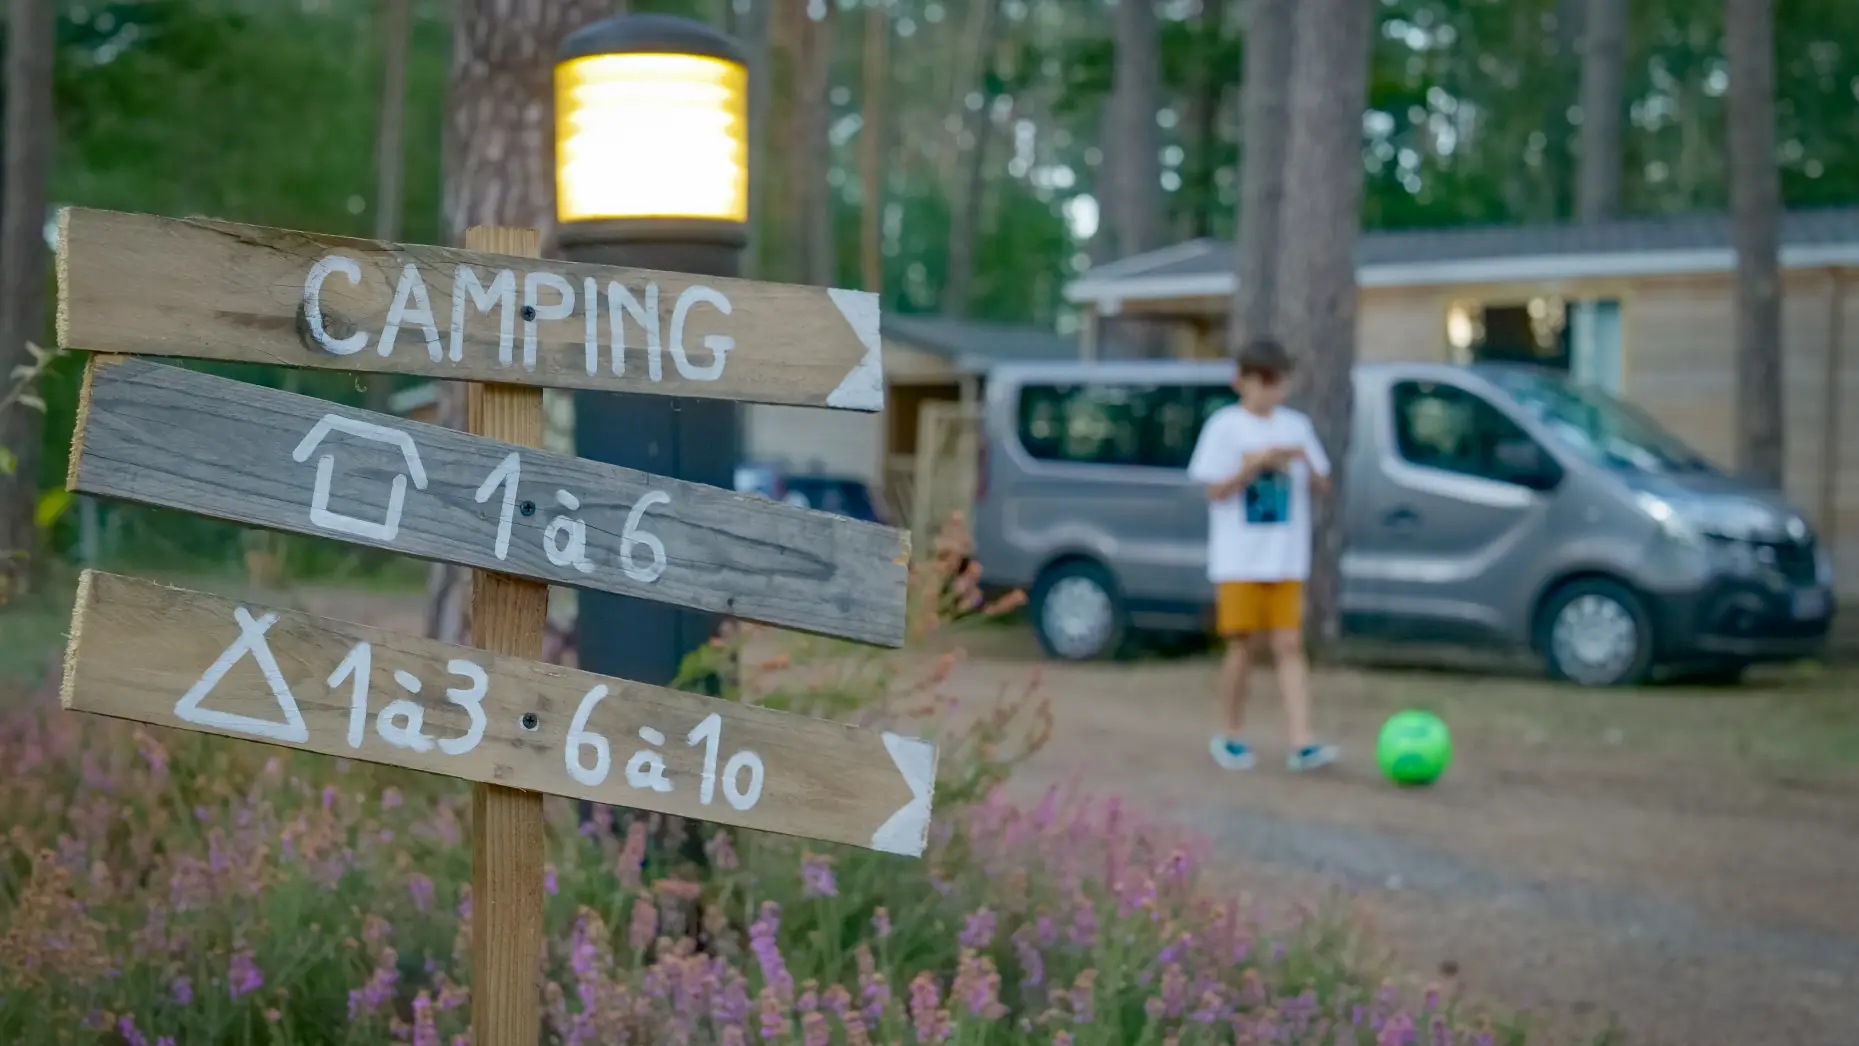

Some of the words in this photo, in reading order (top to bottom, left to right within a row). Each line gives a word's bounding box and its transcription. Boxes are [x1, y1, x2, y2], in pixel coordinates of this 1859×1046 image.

[303, 256, 735, 382] CAMPING
[475, 452, 520, 561] 1
[543, 490, 595, 574] à
[620, 491, 671, 584] 6
